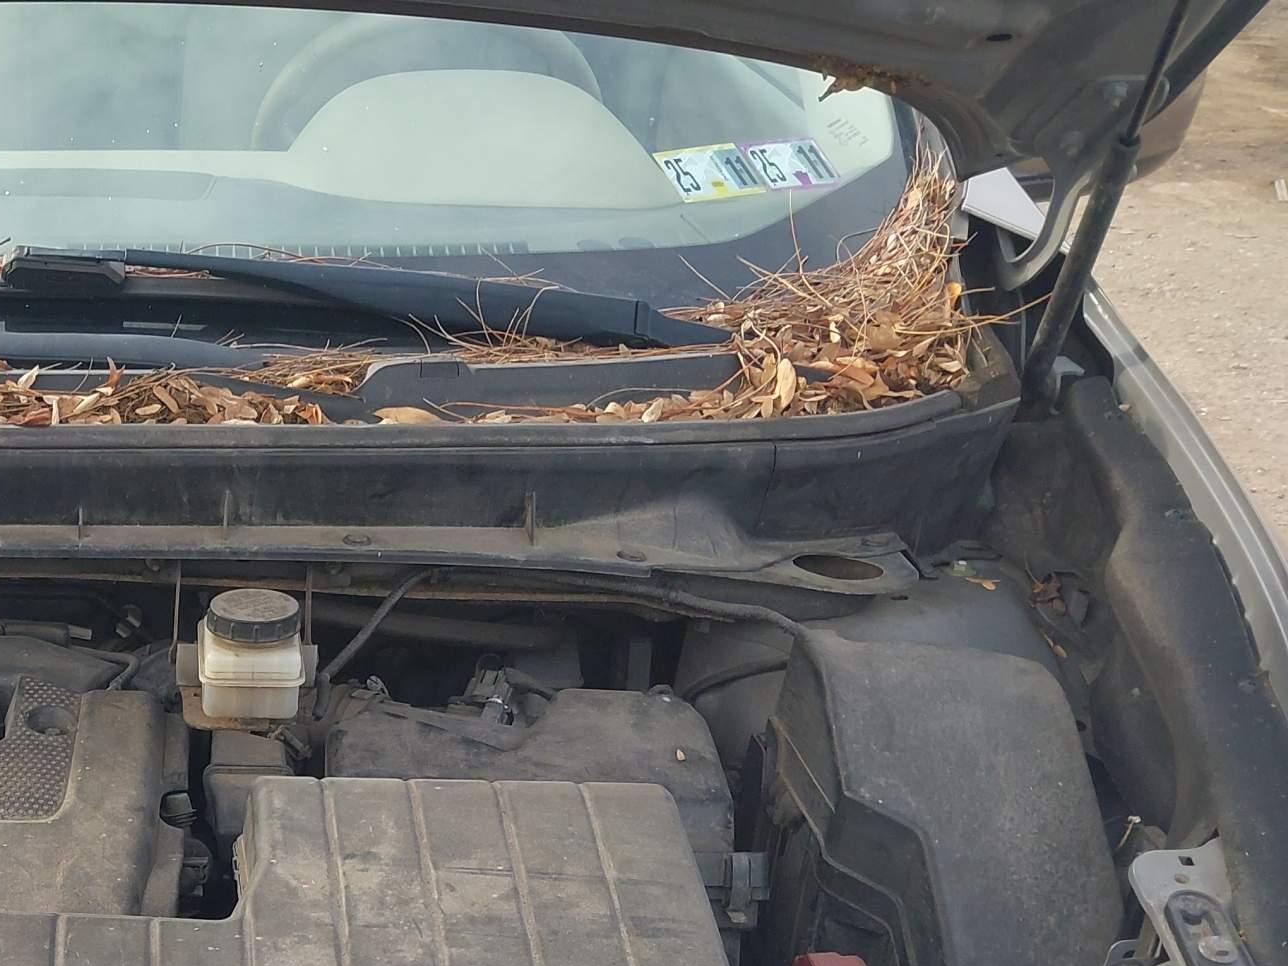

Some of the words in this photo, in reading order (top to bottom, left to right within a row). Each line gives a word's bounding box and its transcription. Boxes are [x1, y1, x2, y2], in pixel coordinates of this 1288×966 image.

[664, 158, 701, 192] 25
[724, 155, 758, 186] 11
[749, 148, 787, 183] 25
[796, 144, 835, 178] 11
